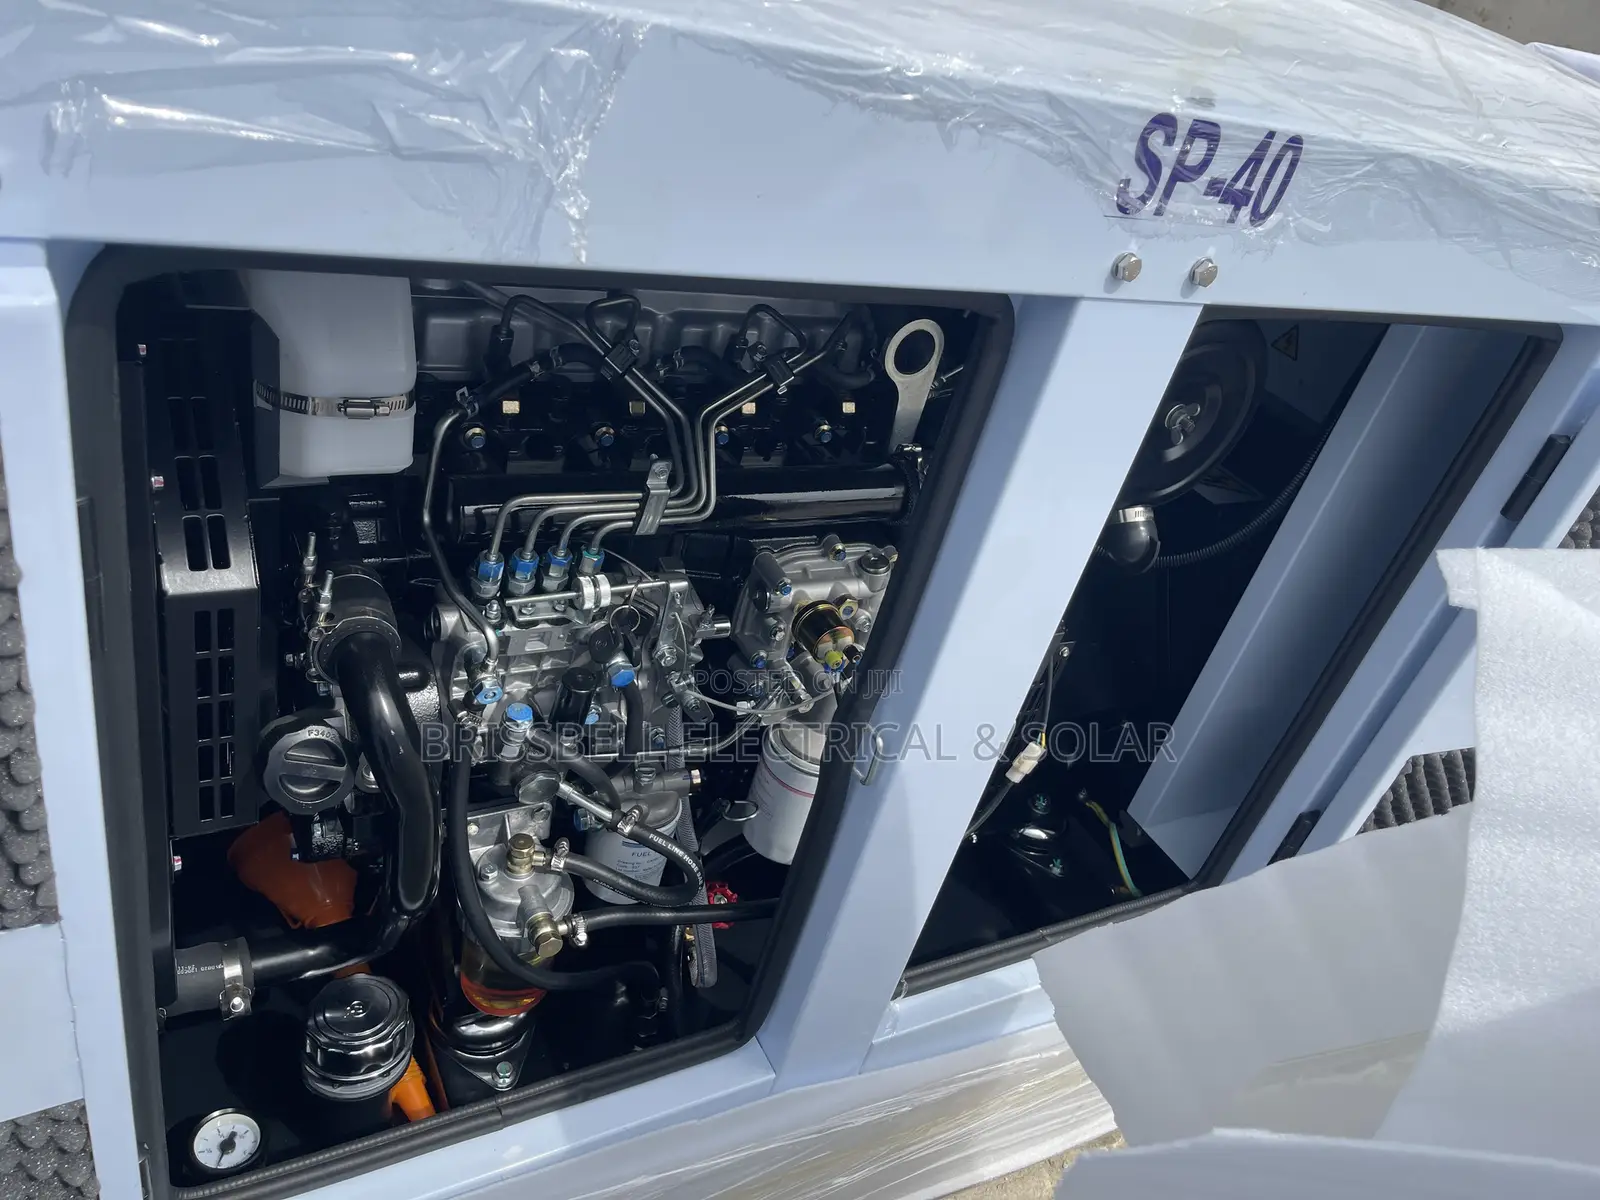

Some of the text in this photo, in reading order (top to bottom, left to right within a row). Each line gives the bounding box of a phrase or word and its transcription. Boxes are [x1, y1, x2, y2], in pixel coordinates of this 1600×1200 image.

[1115, 112, 1304, 228] SP-40
[649, 834, 666, 847] FUEL
[668, 844, 684, 857] LINE
[683, 855, 699, 872] HOSE
